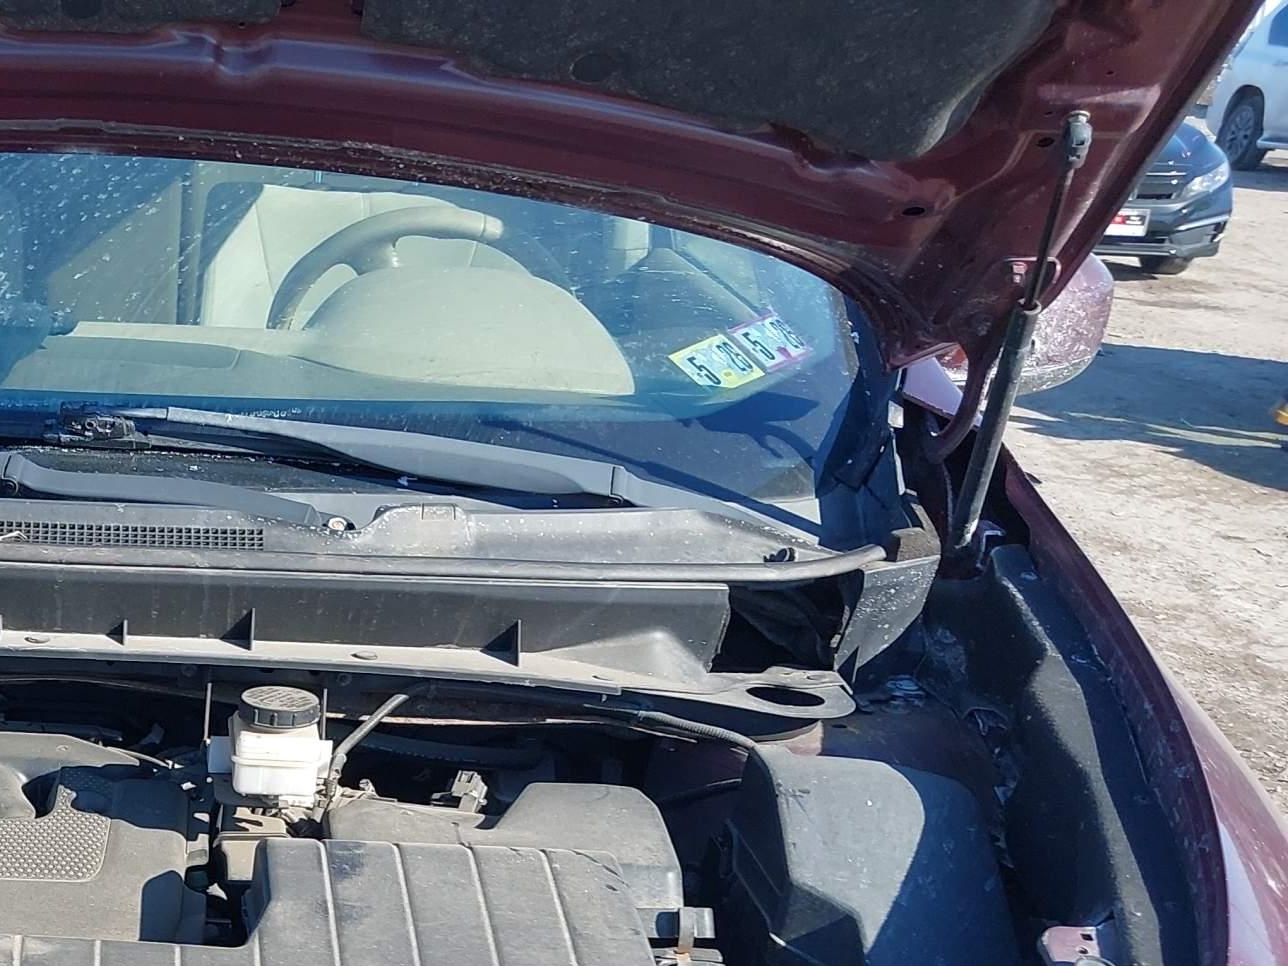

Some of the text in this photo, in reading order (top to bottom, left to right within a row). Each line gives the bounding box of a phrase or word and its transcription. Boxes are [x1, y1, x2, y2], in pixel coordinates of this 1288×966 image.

[686, 342, 754, 386] 5 26
[741, 332, 776, 361] 5
